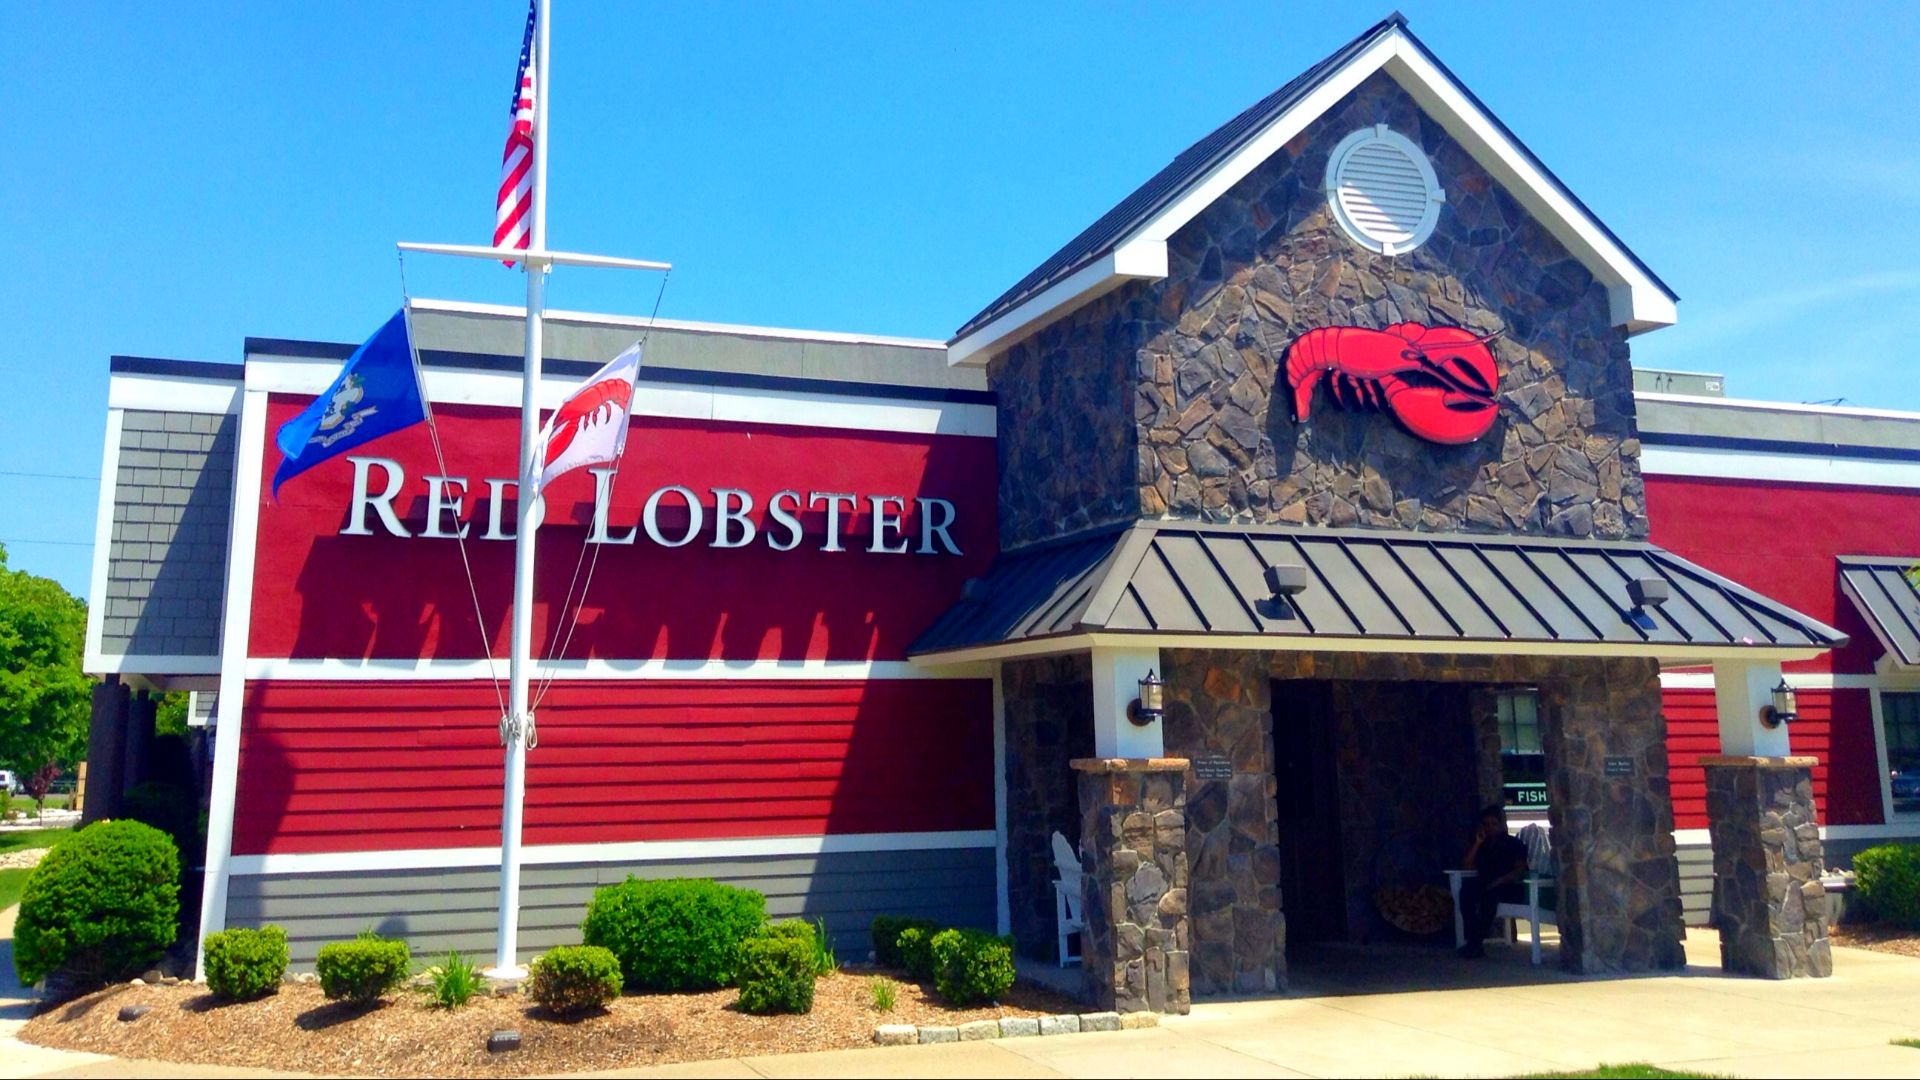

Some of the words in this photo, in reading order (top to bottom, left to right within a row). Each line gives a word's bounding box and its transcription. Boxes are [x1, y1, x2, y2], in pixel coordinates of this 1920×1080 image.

[339, 455, 546, 540] RED
[584, 467, 964, 556] LOBSTER
[1517, 790, 1547, 802] FISH
